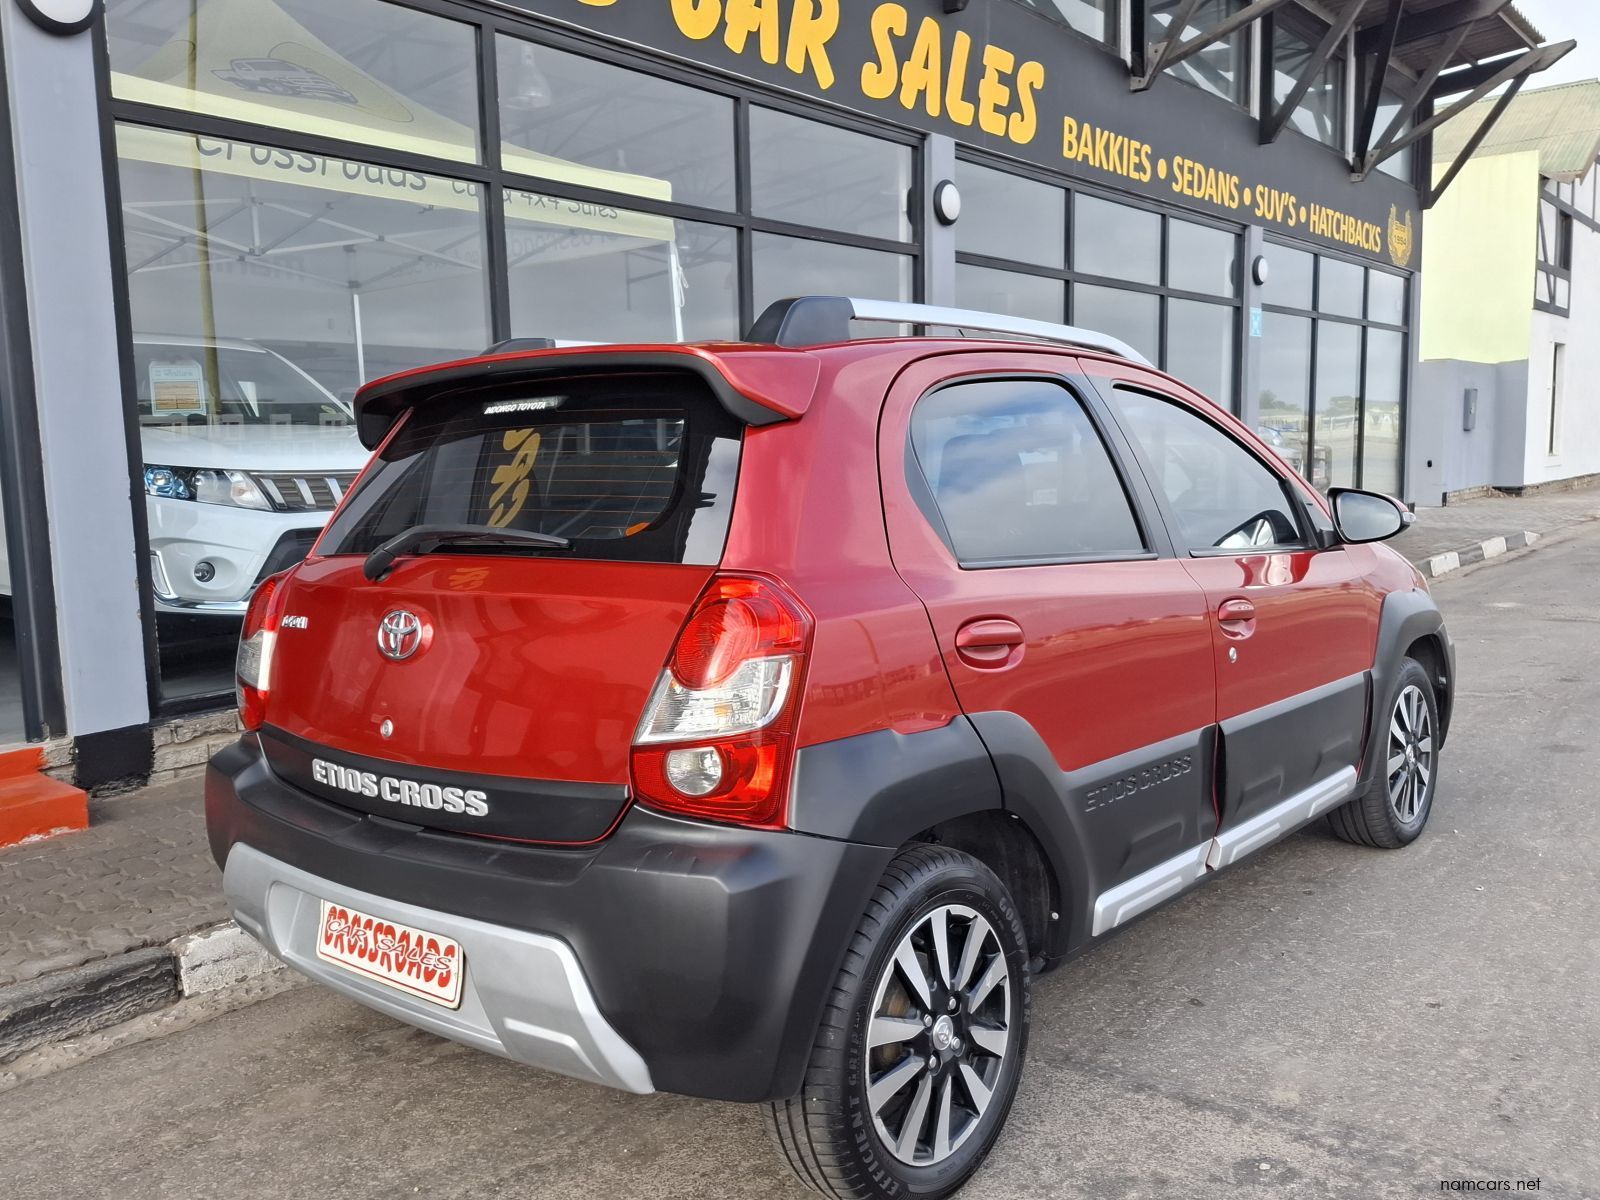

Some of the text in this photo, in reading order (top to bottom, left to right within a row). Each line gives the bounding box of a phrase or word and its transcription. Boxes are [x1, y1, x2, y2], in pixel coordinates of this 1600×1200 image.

[861, 2, 1045, 144] SALES
[1063, 116, 1381, 253] BAKKIES SEDANS SUV'S HATCHBACKS
[517, 402, 546, 411] TOYOTA
[312, 758, 488, 816] ETIOS CROSS
[1085, 755, 1191, 812] ETIOS CROSS
[328, 921, 452, 970] CAR SALES
